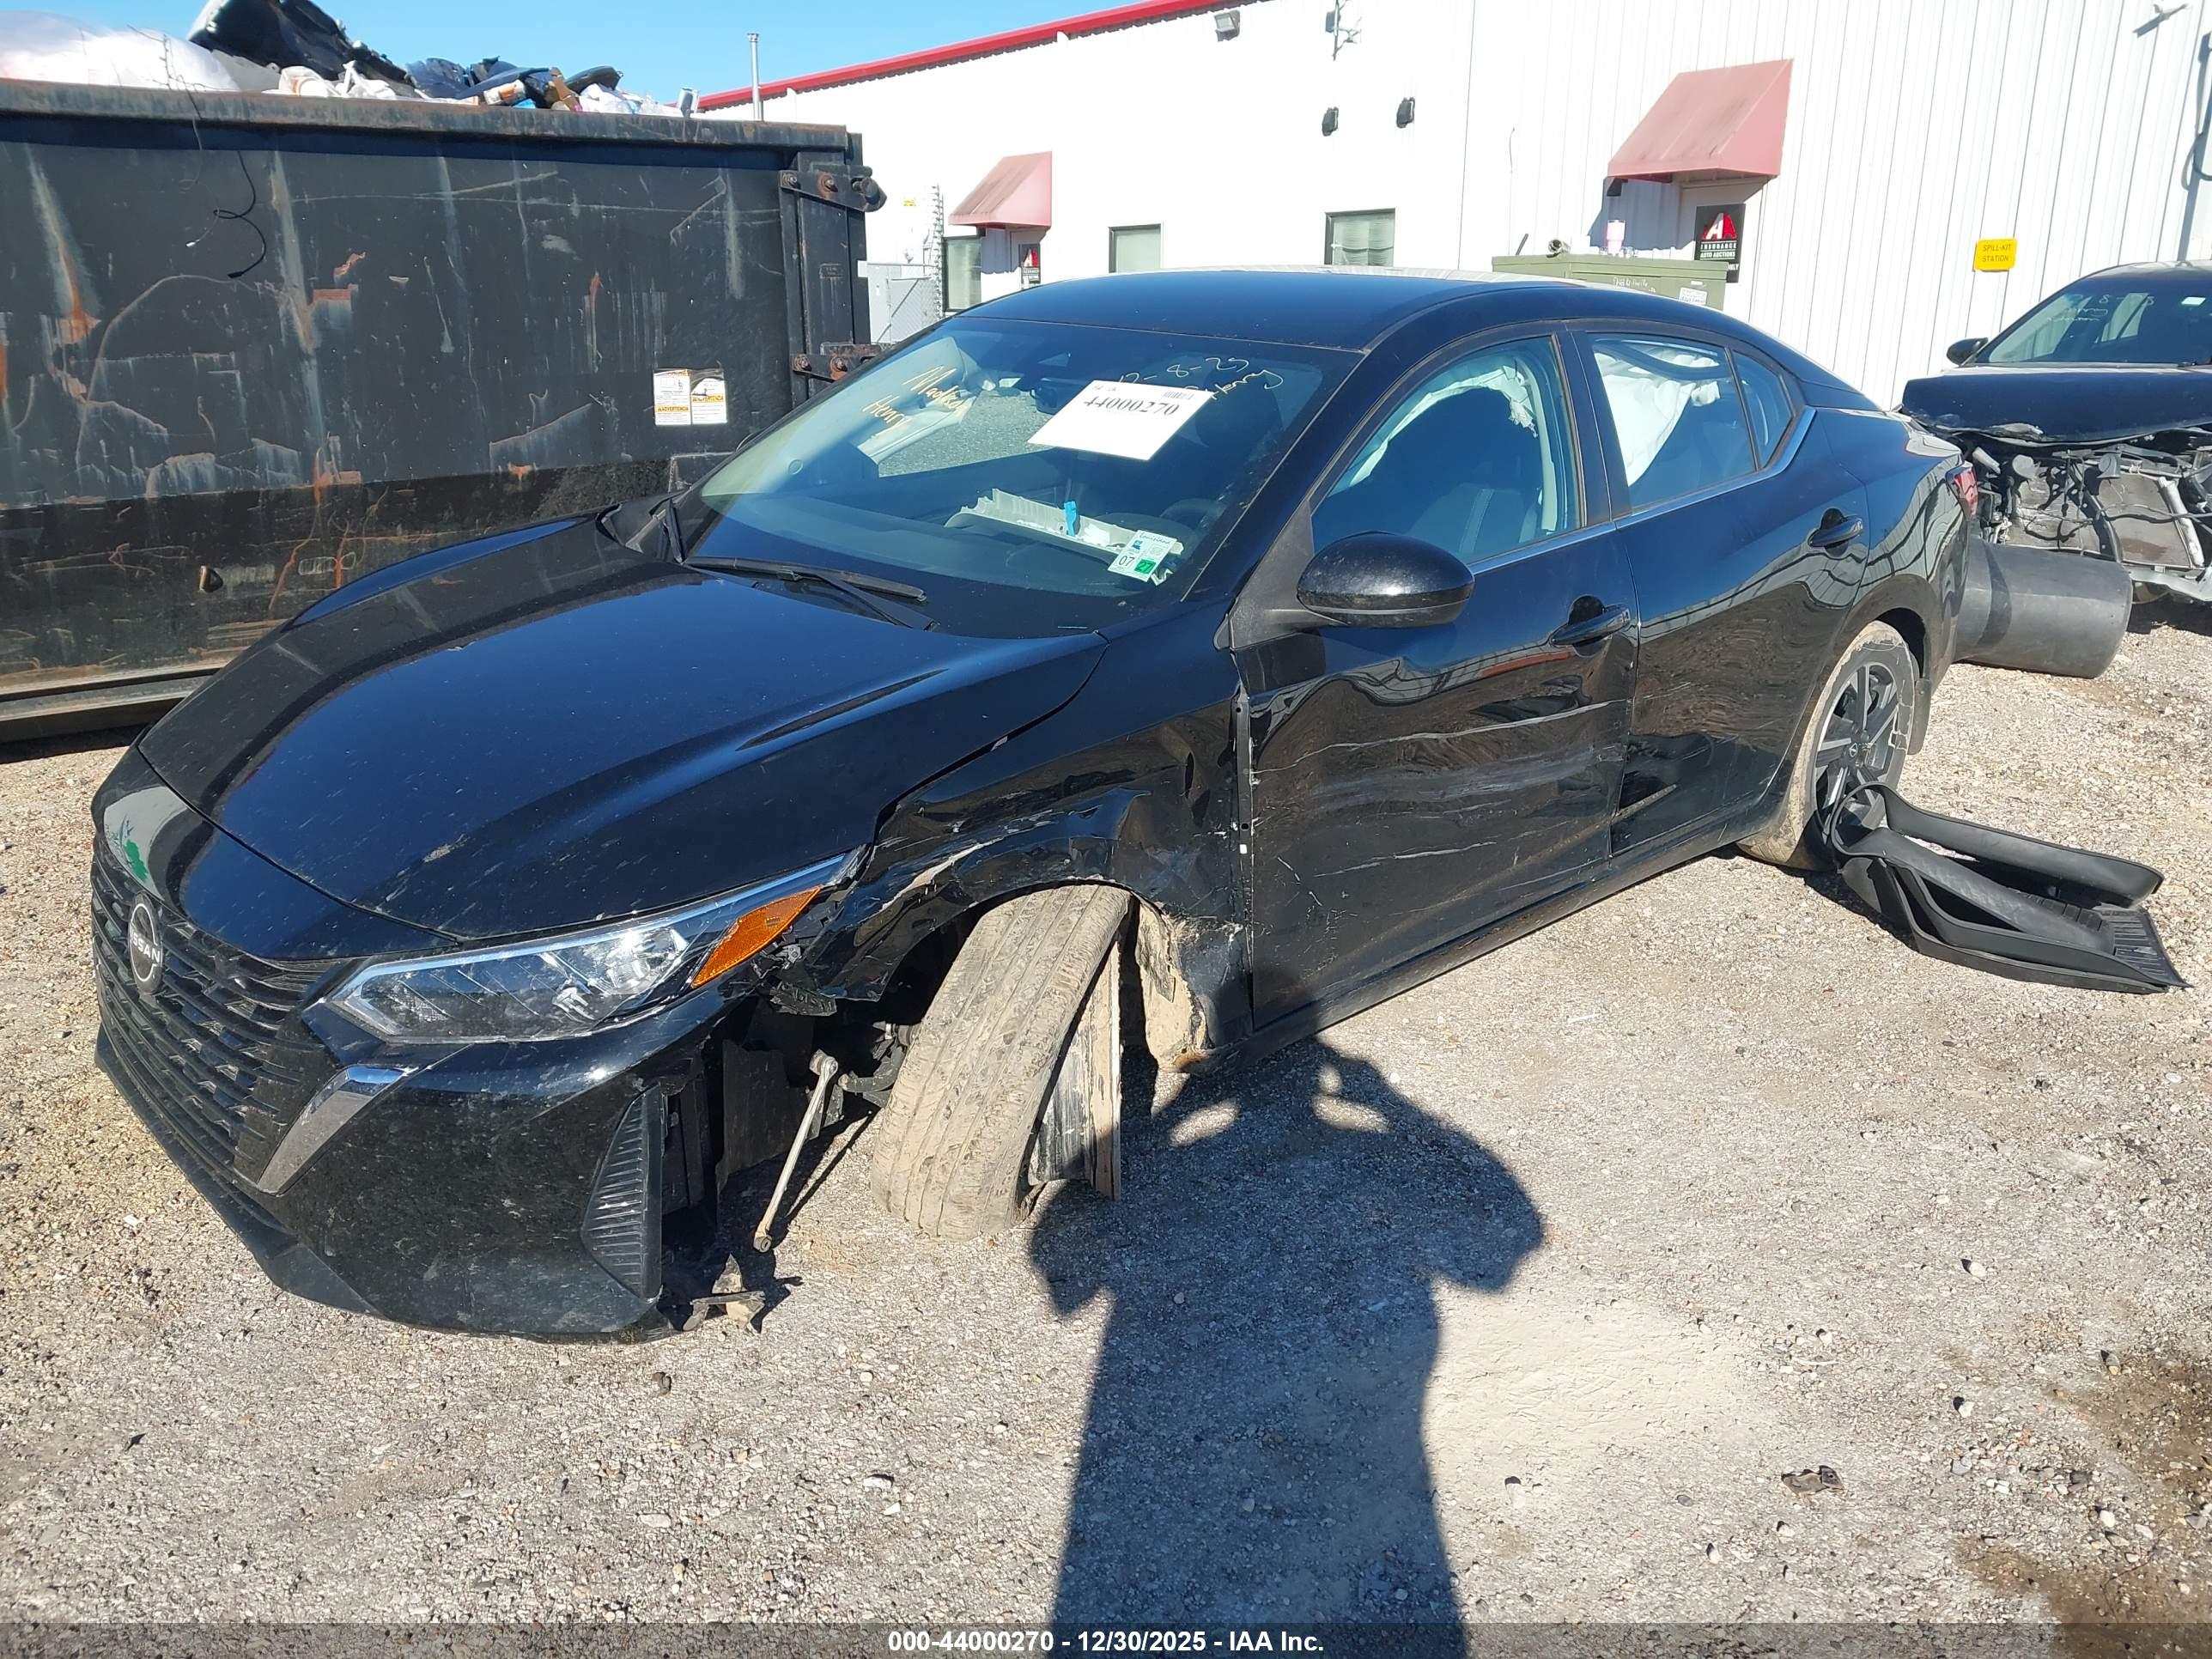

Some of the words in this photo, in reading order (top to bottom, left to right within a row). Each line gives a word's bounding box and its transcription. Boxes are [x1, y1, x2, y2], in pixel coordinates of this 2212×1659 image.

[1084, 397, 1180, 416] 44000270
[1119, 555, 1135, 567] 07
[1138, 560, 1153, 573] 27
